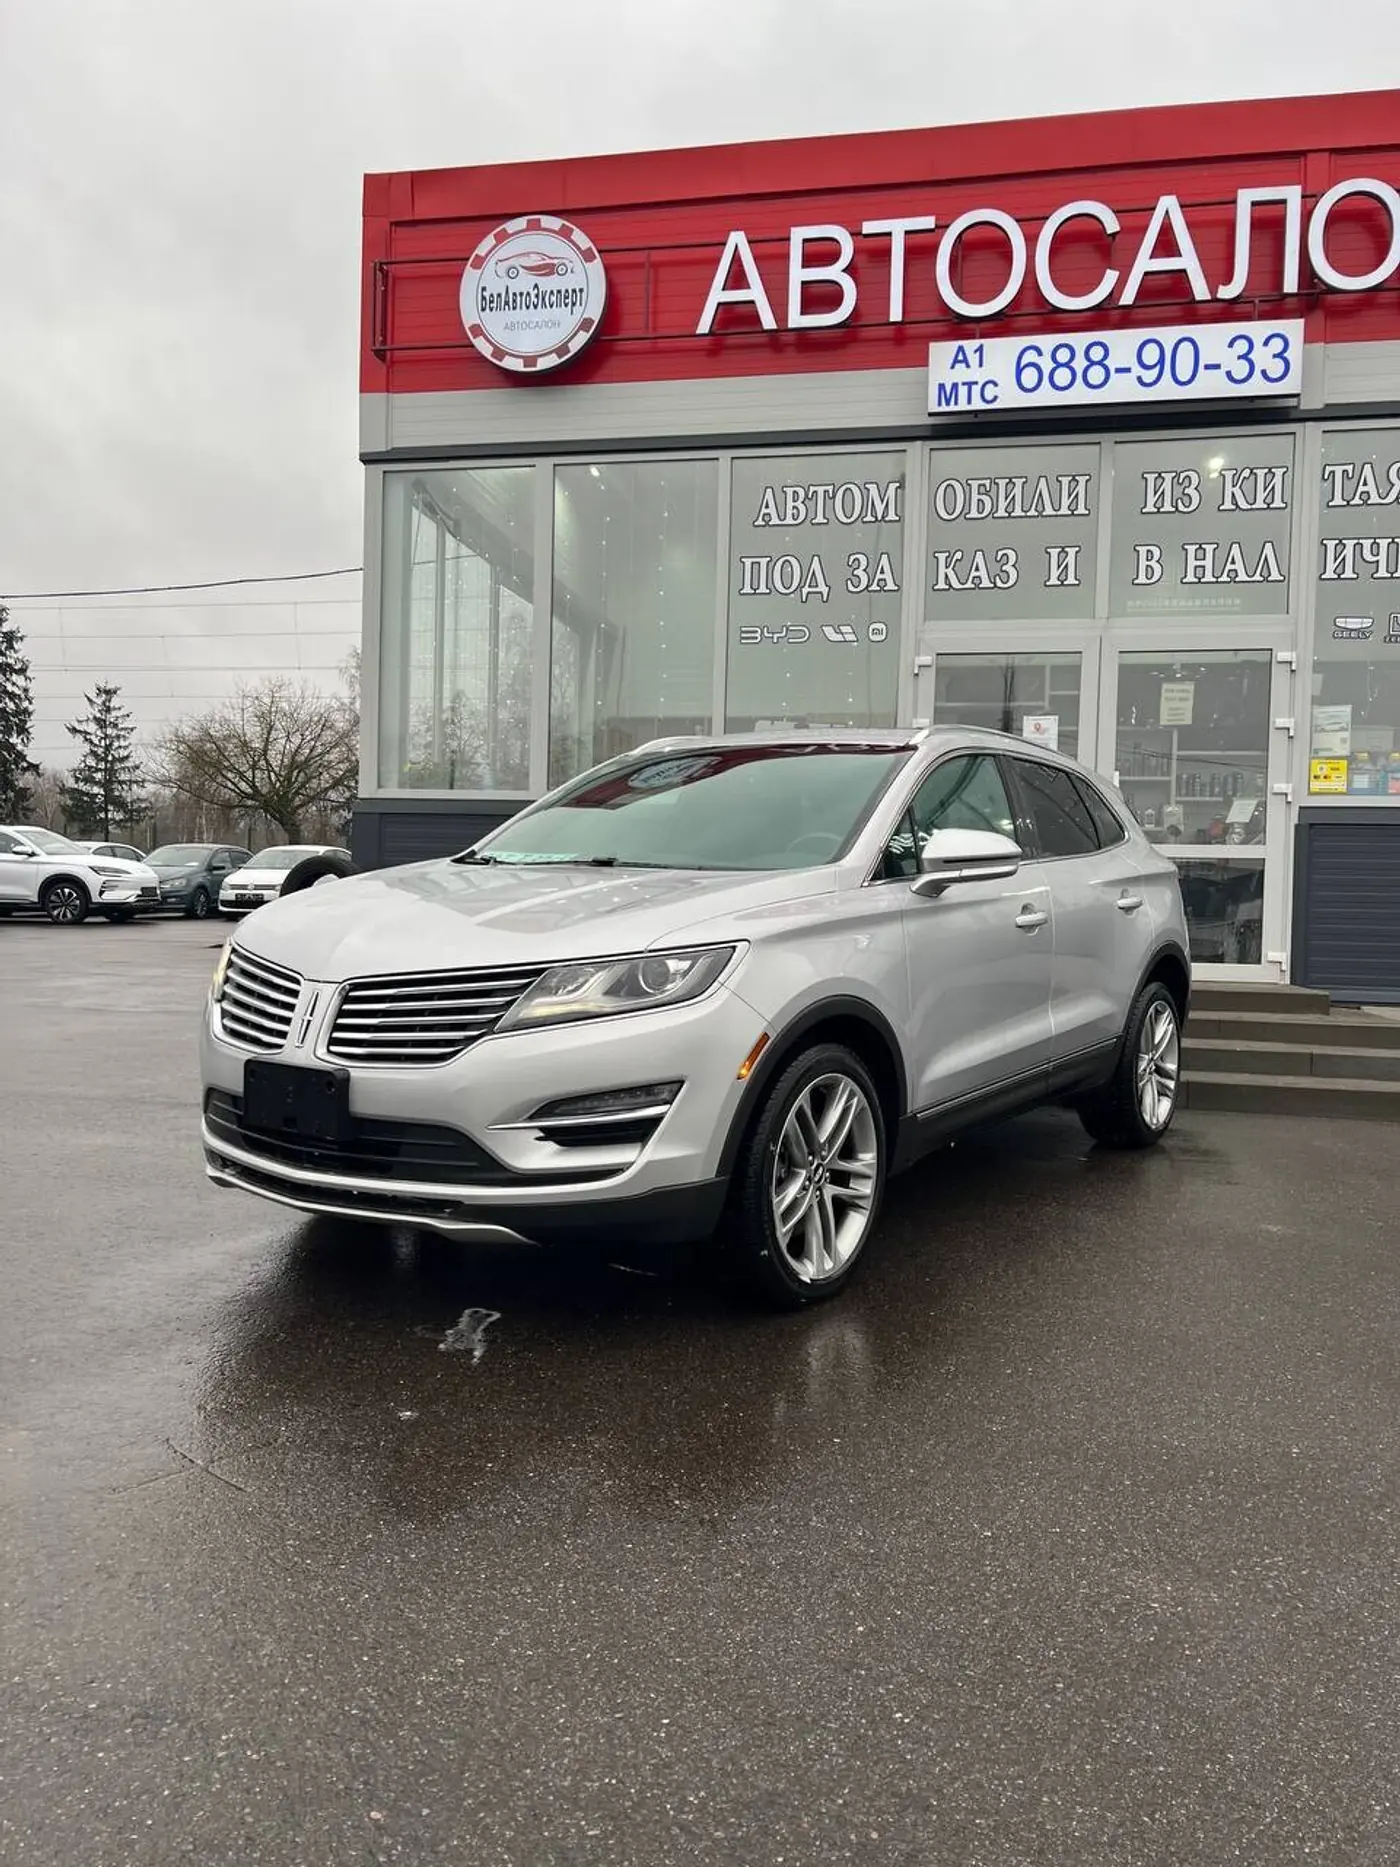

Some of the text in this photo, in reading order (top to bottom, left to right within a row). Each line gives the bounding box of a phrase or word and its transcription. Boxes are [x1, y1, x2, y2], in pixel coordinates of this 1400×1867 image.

[695, 177, 1400, 334] АВТОСАЛО
[480, 283, 585, 316] БелАвтоЭксперт
[503, 319, 562, 332] АВТОСАЛОН
[1015, 332, 1292, 394] 688-90-33
[937, 380, 999, 408] МТС
[753, 480, 901, 527] АВТОМ
[933, 473, 1091, 521] ОБИЛИ
[1141, 469, 1202, 514] ИЗ
[1218, 466, 1288, 512] КИ
[738, 537, 1400, 603] ПОД ЗА КАЗ И В НАЛ ИЧ
[740, 625, 811, 644] BYD
